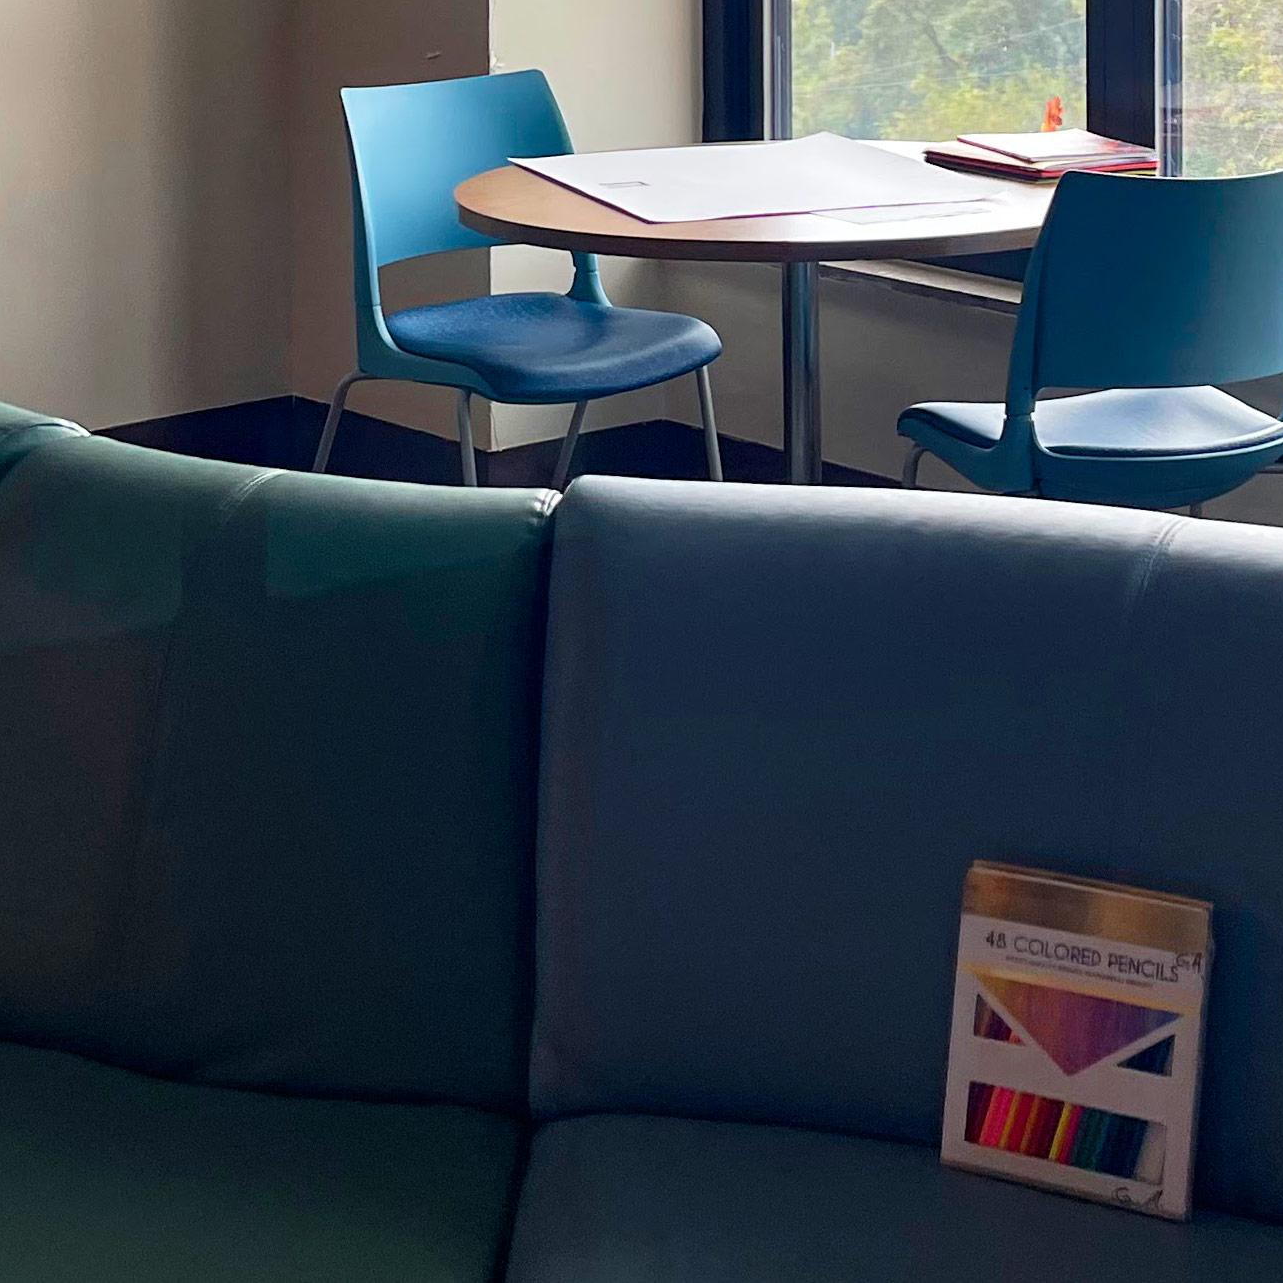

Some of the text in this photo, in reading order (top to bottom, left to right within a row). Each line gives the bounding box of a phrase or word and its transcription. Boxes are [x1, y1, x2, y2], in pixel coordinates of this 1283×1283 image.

[985, 930, 1007, 950] 48
[1013, 935, 1102, 967] COLORED
[1108, 952, 1179, 983] PENCILS
